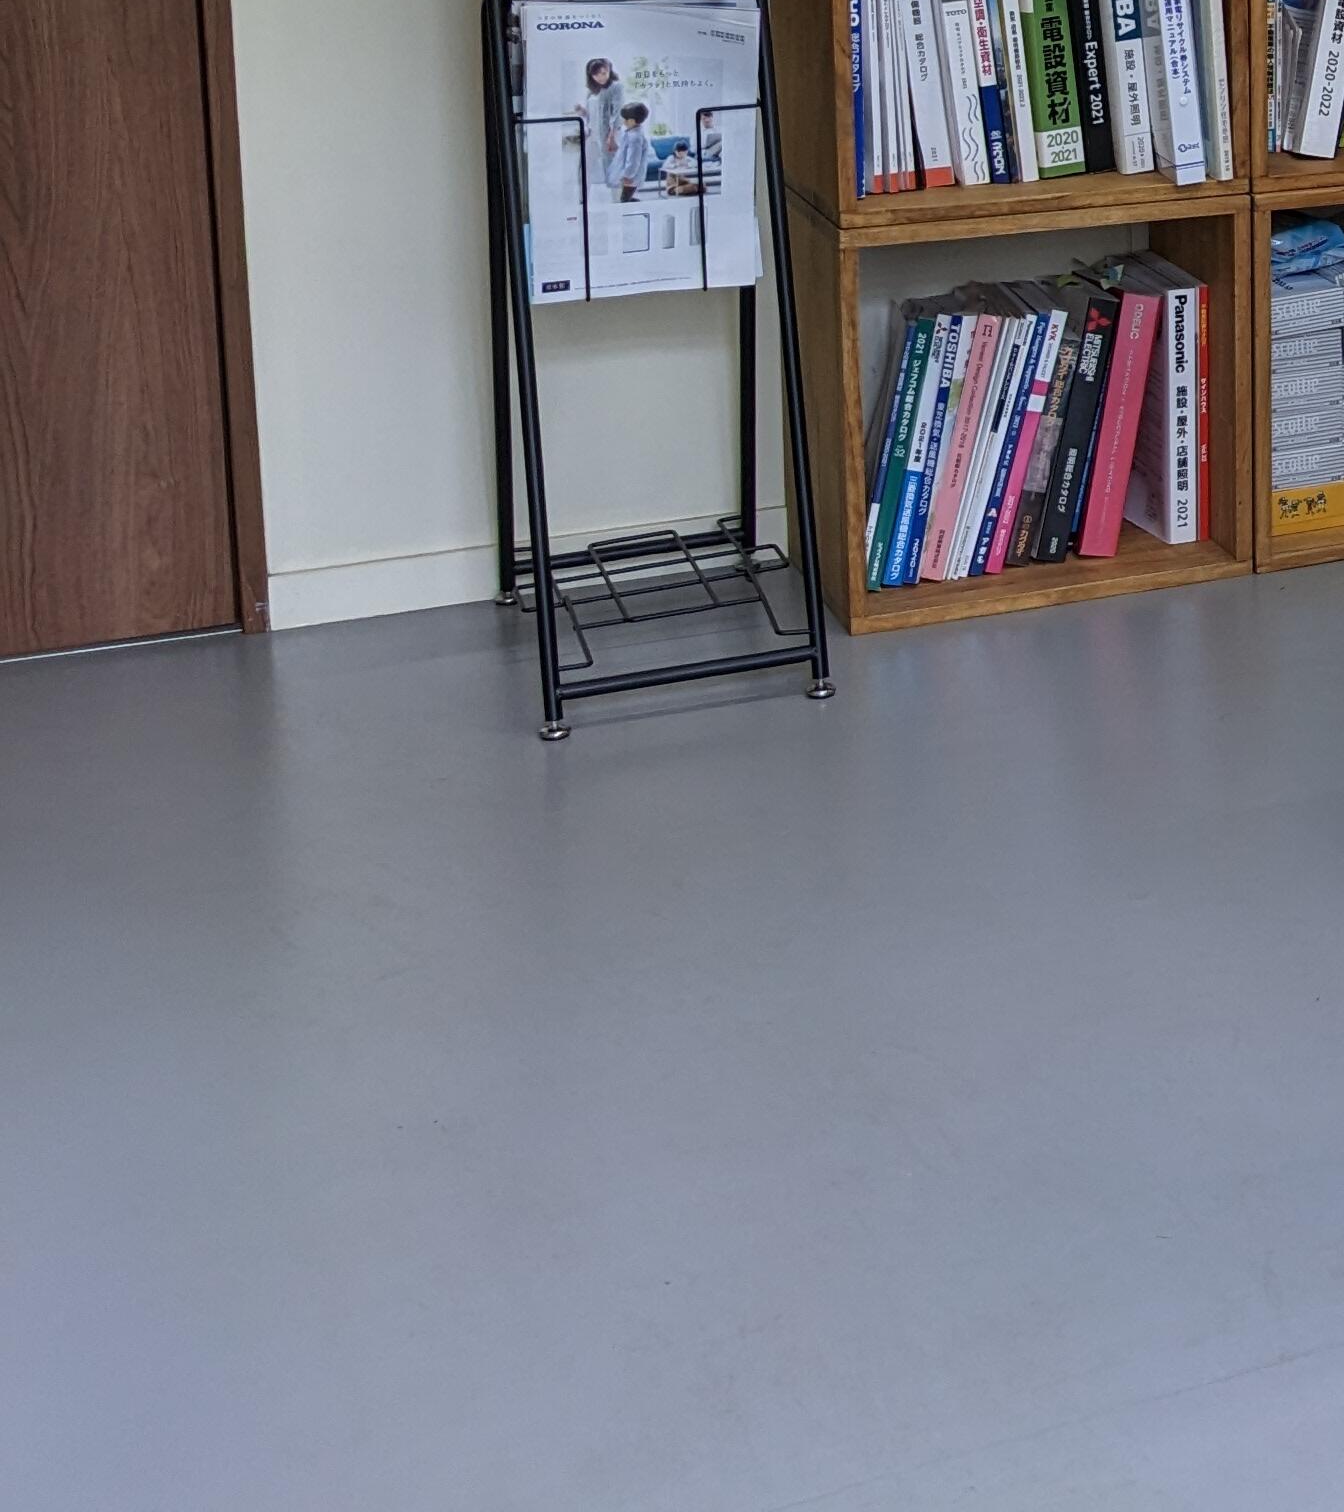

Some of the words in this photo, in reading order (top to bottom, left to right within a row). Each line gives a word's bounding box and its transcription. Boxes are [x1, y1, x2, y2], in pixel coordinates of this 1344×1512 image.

[536, 19, 605, 31] CORONA
[945, 8, 967, 17] TOTO
[914, 32, 928, 82] 総合カタログ
[1040, 15, 1073, 126] 電設資材
[1084, 40, 1101, 90] Expert
[1123, 48, 1142, 127] 施設・屋外照明
[1318, 50, 1340, 117] 2020-2022
[1089, 93, 1105, 126] 2021
[1046, 129, 1080, 148] 2020
[1050, 147, 1079, 164] 2021
[915, 332, 927, 355] 2021
[1049, 324, 1059, 342] KVK
[1129, 303, 1145, 340] ODELIC
[1174, 294, 1189, 373] Panasonic
[939, 323, 960, 389] TOSHIBA
[1078, 332, 1094, 376] ELECTRIC
[1091, 334, 1103, 383] MITSUBISHI
[1175, 385, 1189, 492] 施設・屋外・店舗照明
[1057, 447, 1079, 514] 照明総合カタログ
[1176, 499, 1189, 529] 2021
